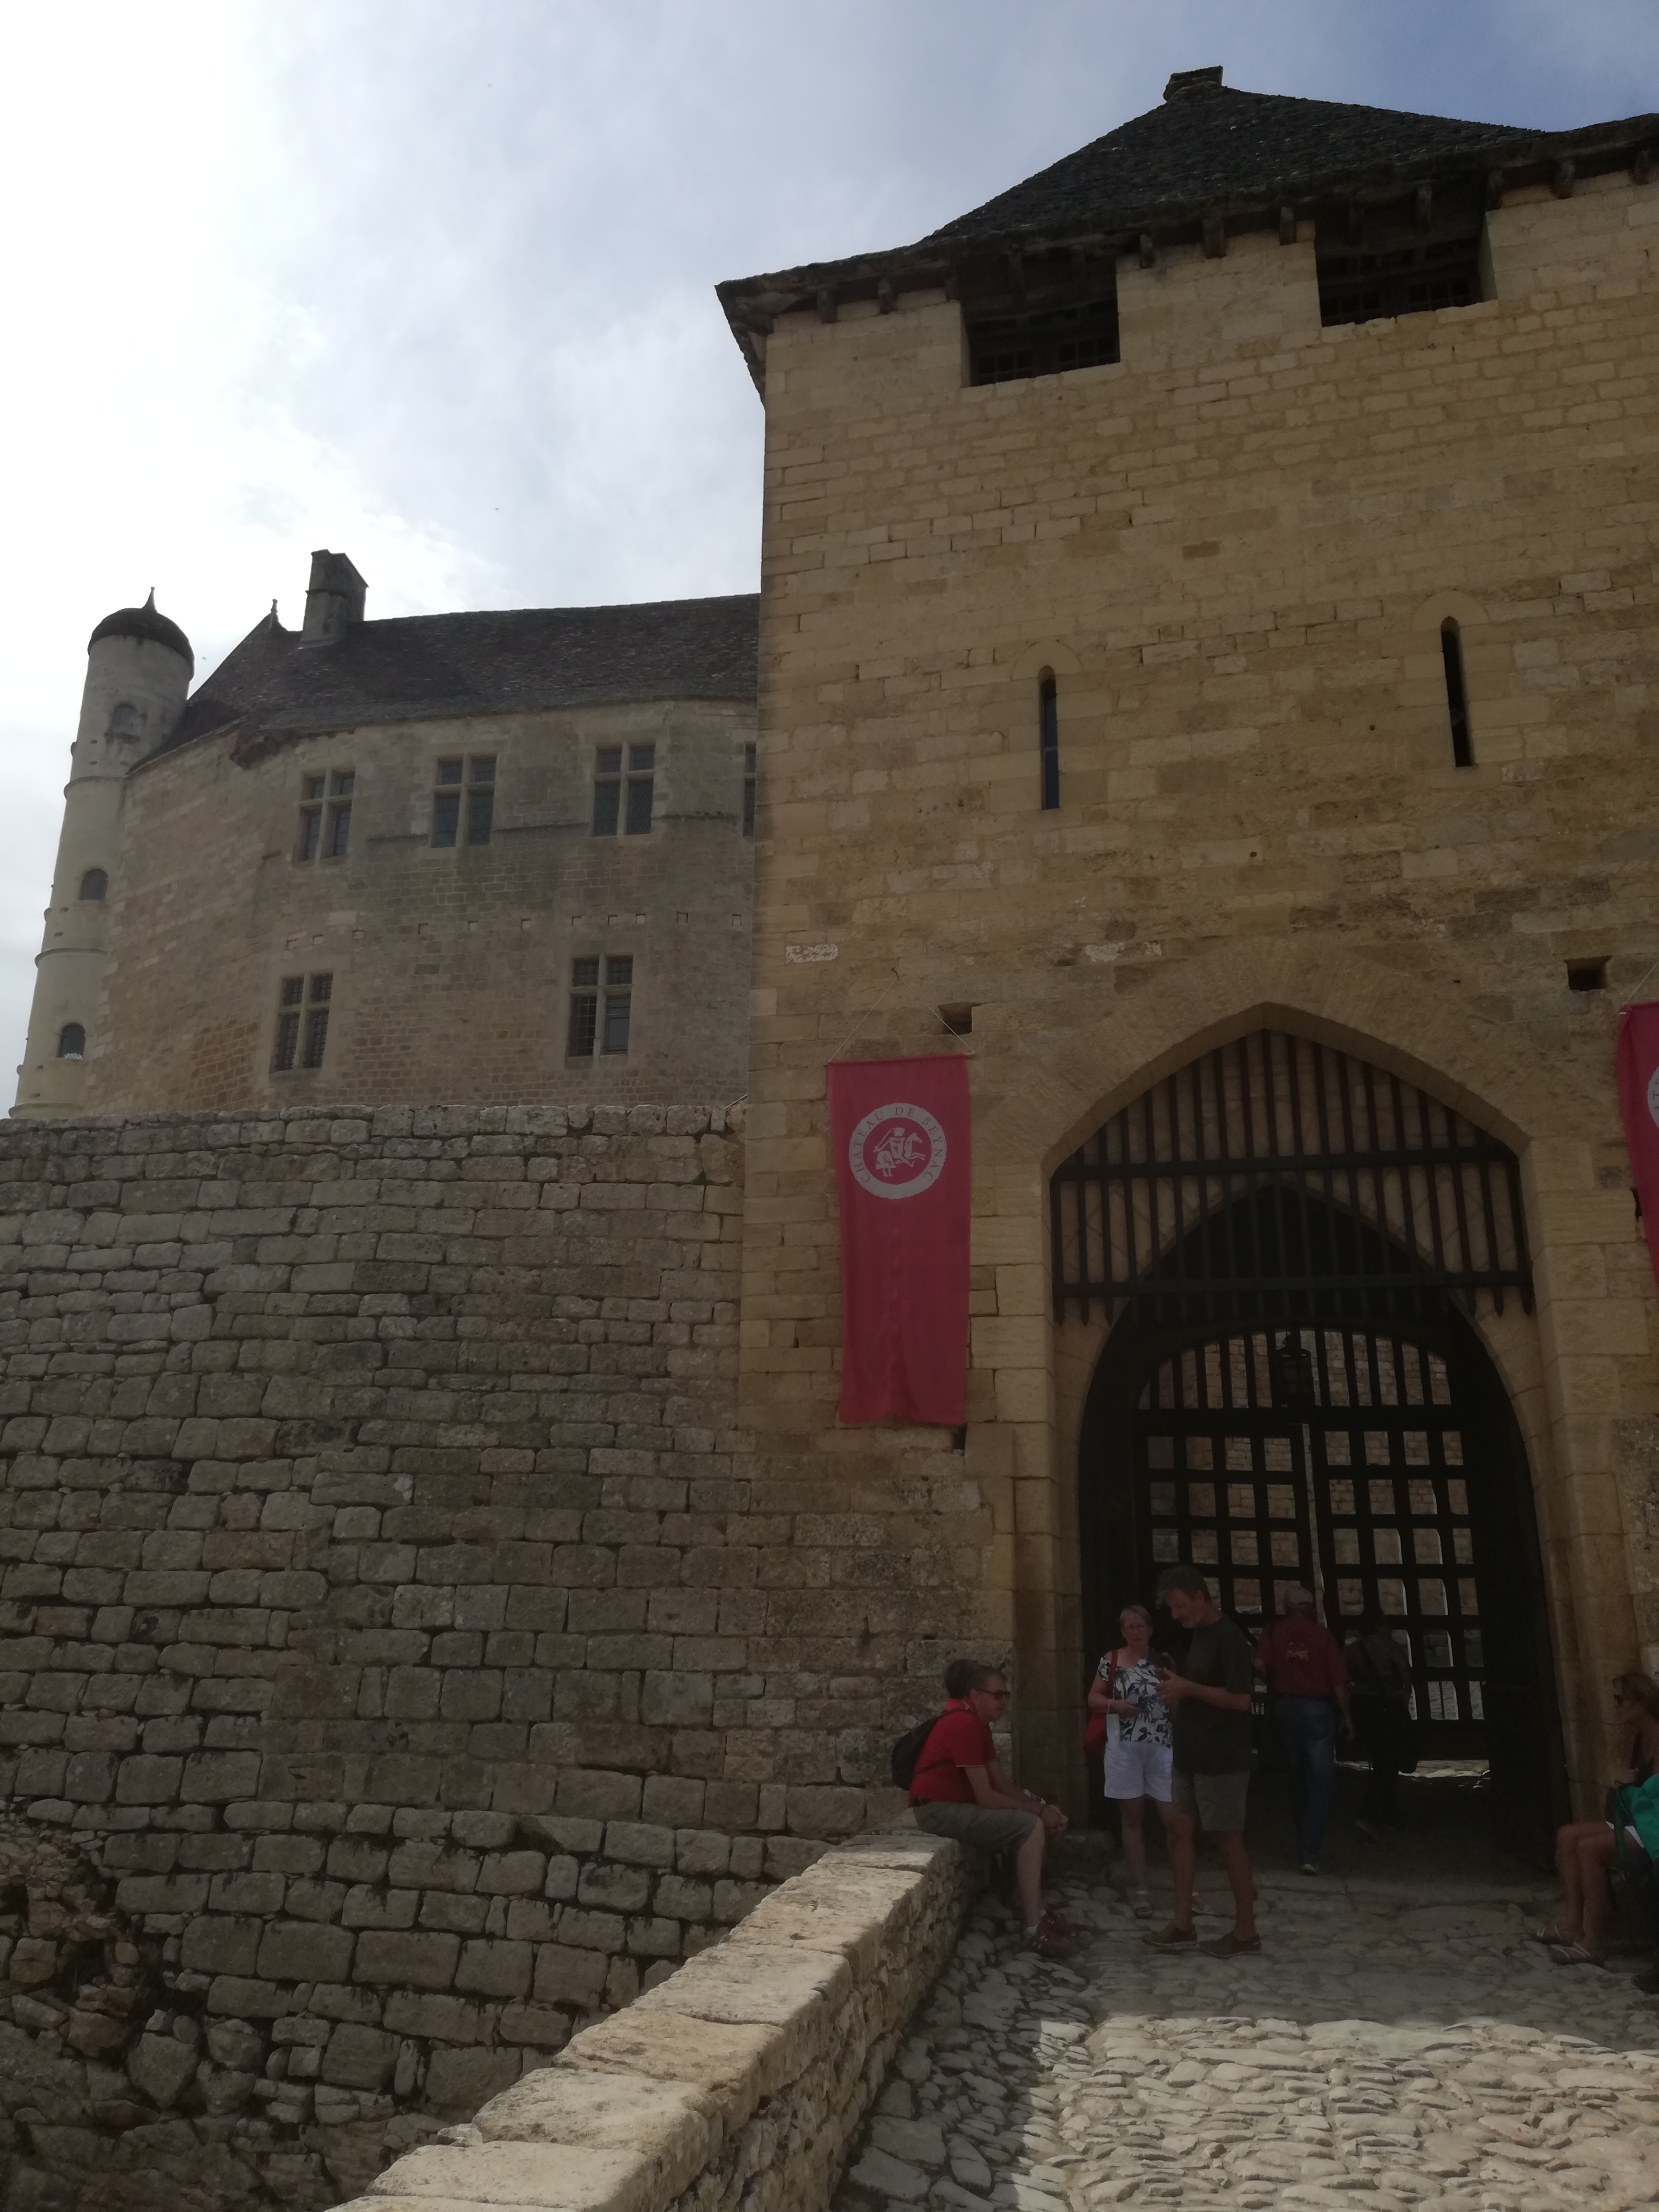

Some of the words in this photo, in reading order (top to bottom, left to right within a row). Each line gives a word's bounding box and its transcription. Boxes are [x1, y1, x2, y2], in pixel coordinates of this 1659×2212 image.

[853, 1111, 884, 1183] CHATEAU
[895, 1106, 915, 1118] DE
[921, 1116, 943, 1182] BEYNAC
